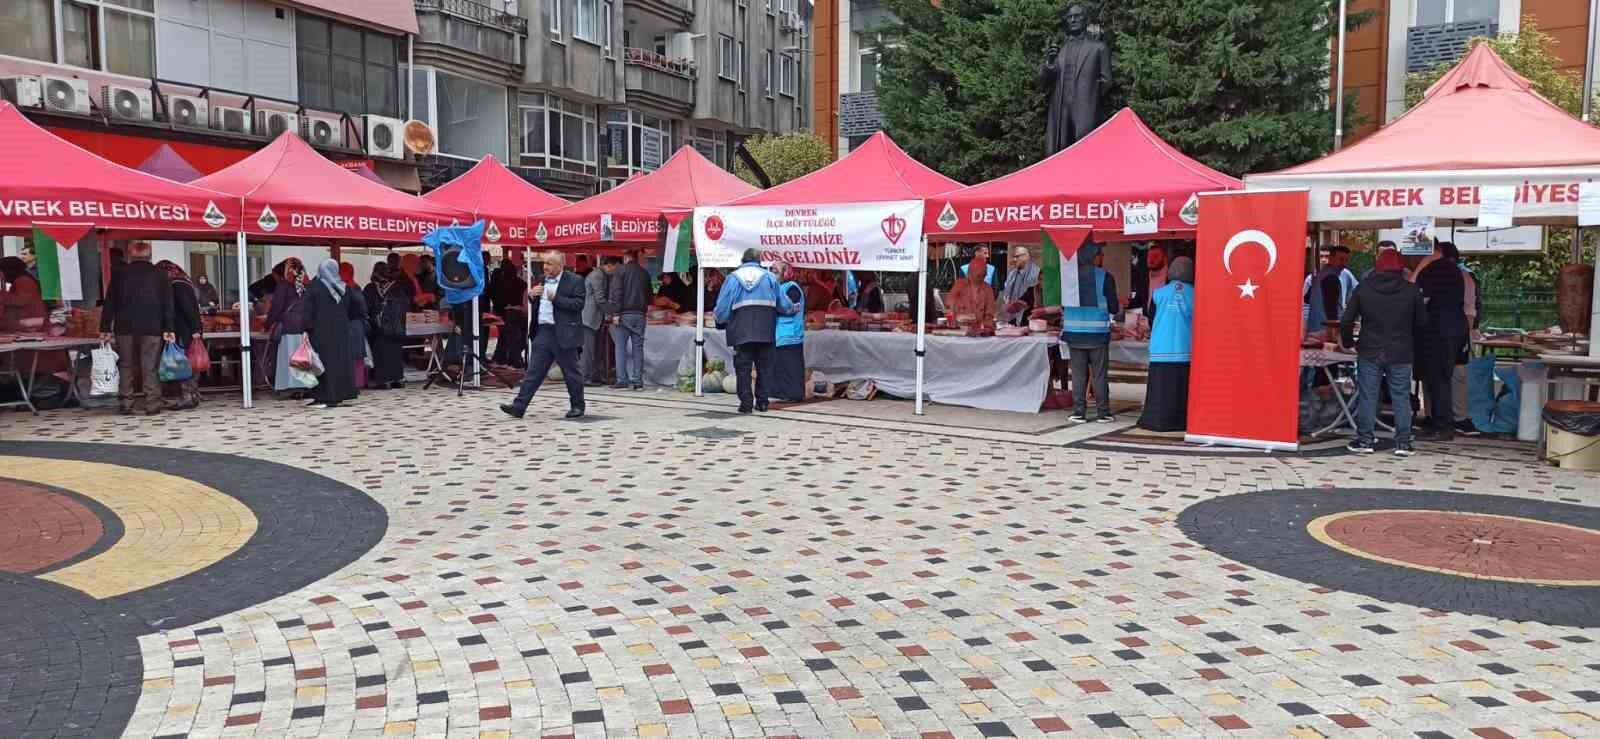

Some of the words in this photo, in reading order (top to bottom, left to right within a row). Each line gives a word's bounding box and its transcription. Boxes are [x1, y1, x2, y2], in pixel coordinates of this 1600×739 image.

[1329, 187, 1424, 208] DEVREK
[69, 201, 191, 221] BELEDİYESİ
[785, 208, 817, 217] DEVREK
[972, 204, 1044, 223] DEVREK
[291, 213, 354, 229] DEVREK
[1125, 214, 1156, 225] KASA
[555, 222, 598, 237] DEVREK
[760, 232, 844, 245] KERMESİMİZE
[783, 247, 861, 264] GELDİNİZ
